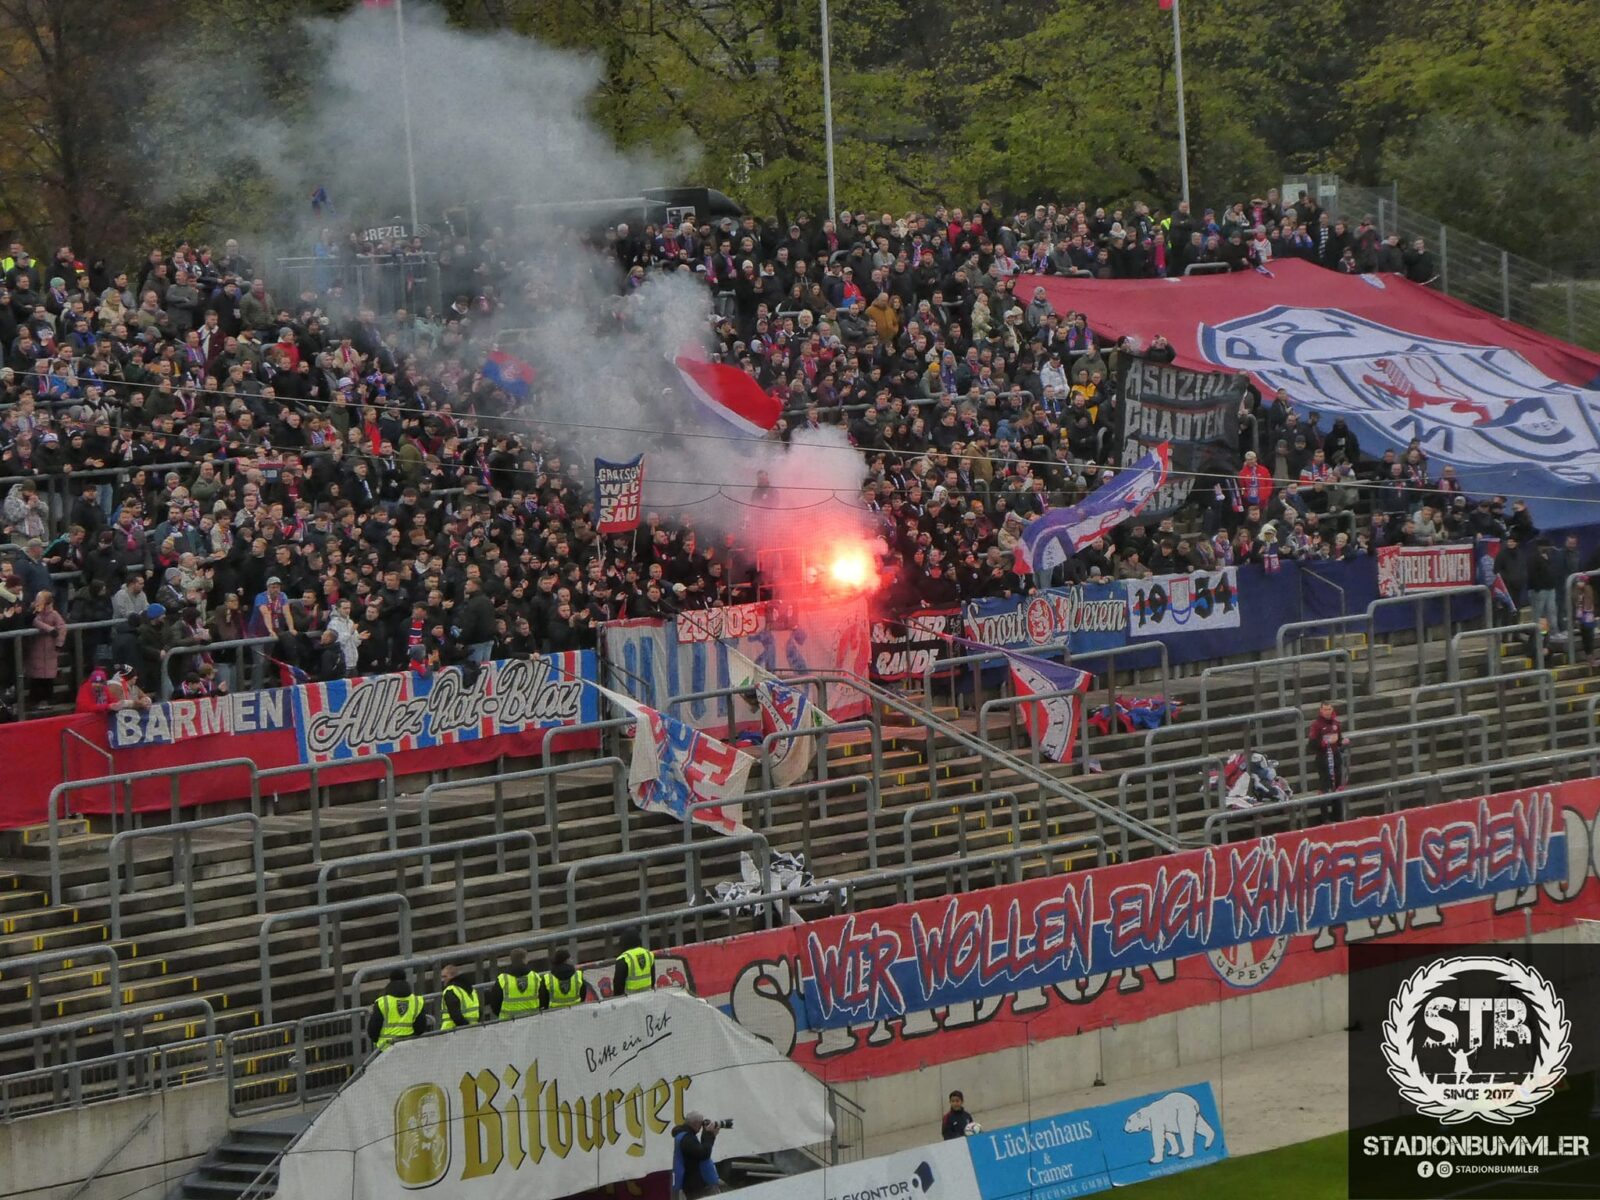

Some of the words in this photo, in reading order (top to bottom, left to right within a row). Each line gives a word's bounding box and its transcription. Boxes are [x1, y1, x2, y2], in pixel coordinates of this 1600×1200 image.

[1124, 398, 1227, 441] CHAOTEN
[600, 480, 640, 496] WEG
[600, 494, 639, 508] DIE
[600, 506, 638, 523] SAU
[1398, 555, 1432, 584] TREUE
[966, 601, 1027, 646] Sport
[1070, 585, 1127, 633] Verein
[876, 648, 940, 675] BANDE
[115, 689, 284, 746] BARMEN
[308, 676, 428, 752] Allez
[429, 657, 582, 735] Rot-Blau
[808, 914, 907, 1020] WIR
[912, 874, 1094, 1001] WOLLEN
[1104, 847, 1216, 958] EUCH
[1225, 816, 1407, 940] KÄMPFEN
[585, 1047, 619, 1073] Bitte
[622, 1035, 642, 1052] ein
[645, 1010, 672, 1037] Bit
[460, 1058, 692, 1181] Bitburger
[990, 1119, 1093, 1161] Lückenhaus
[1027, 1163, 1074, 1187] Cramer
[1043, 1152, 1052, 1165] &
